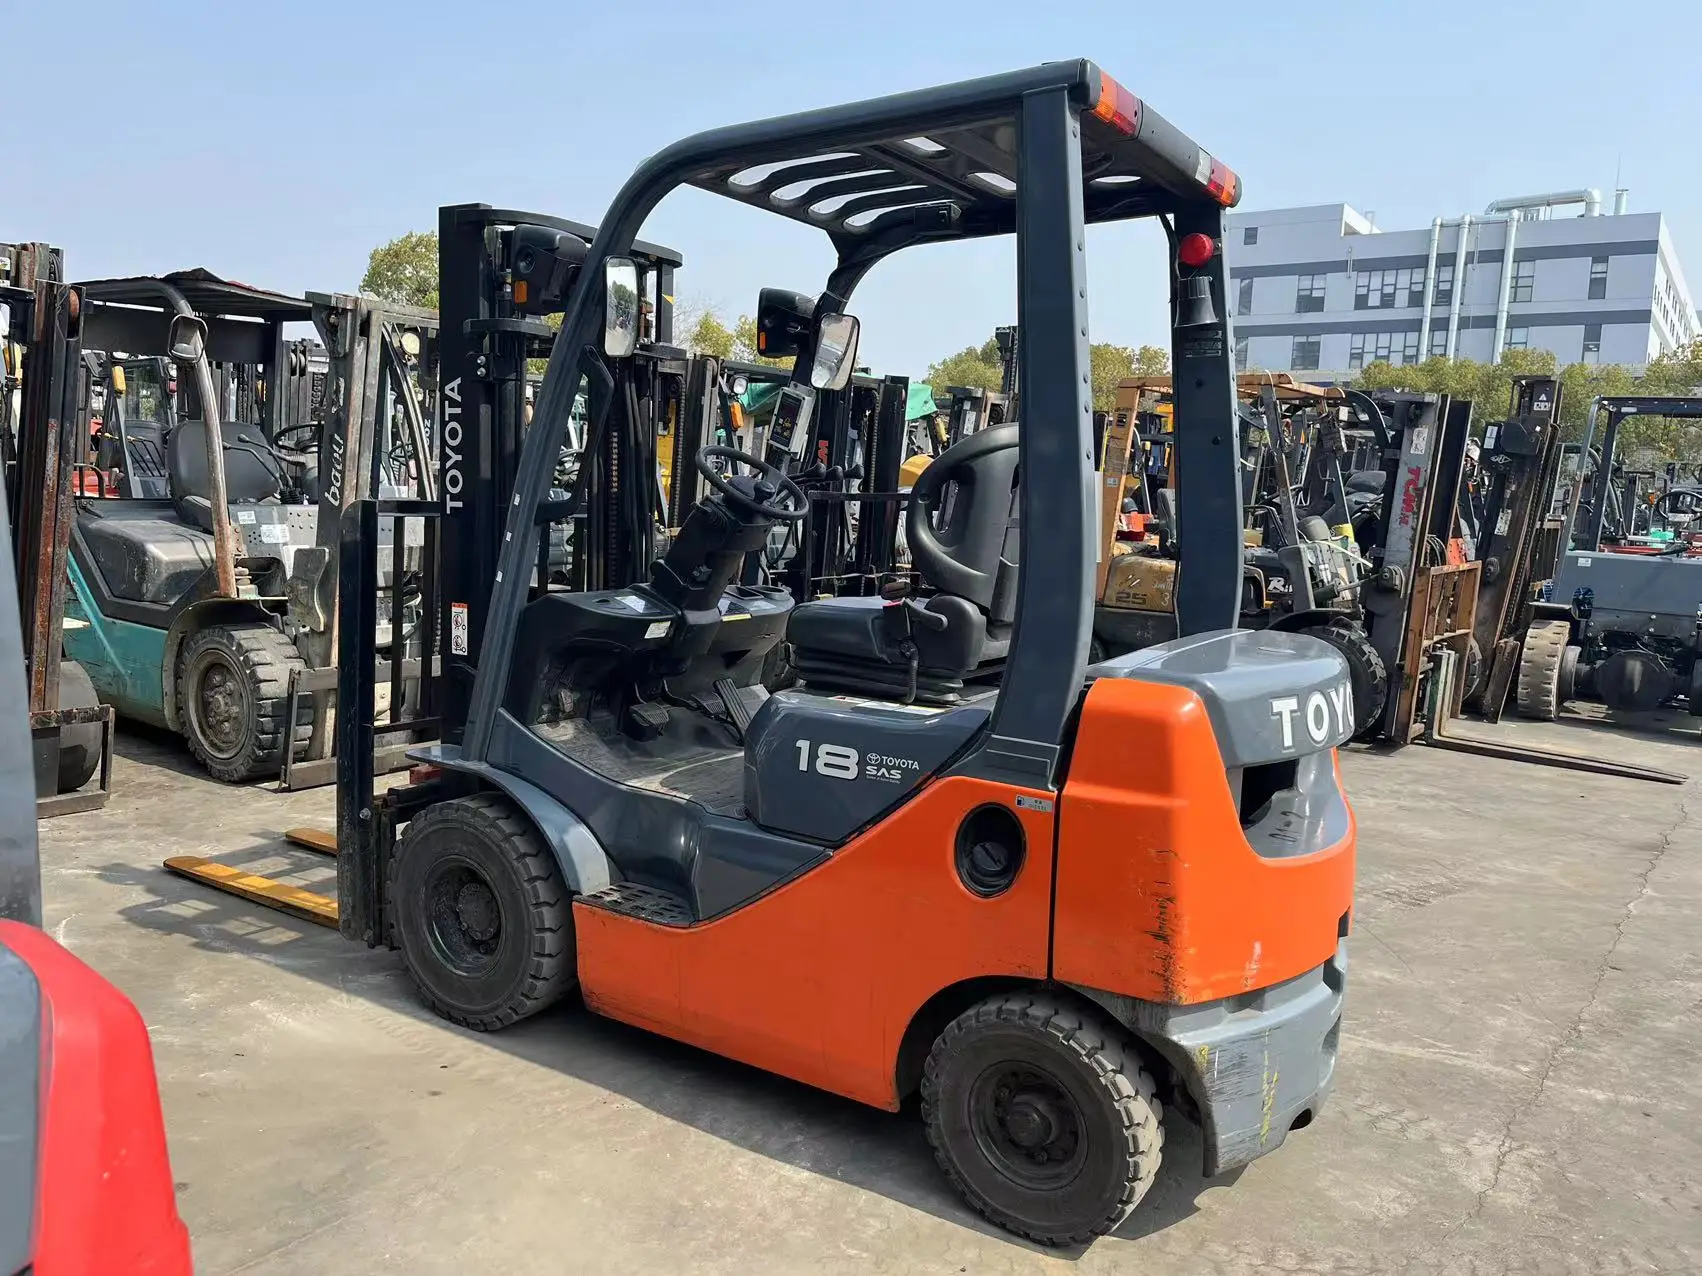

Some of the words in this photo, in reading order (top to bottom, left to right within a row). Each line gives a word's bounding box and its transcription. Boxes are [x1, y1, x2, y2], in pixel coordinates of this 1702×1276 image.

[444, 377, 463, 515] TOYOTA
[795, 739, 859, 780] 18
[865, 765, 902, 779] SAS
[882, 755, 920, 770] TOYOTA
